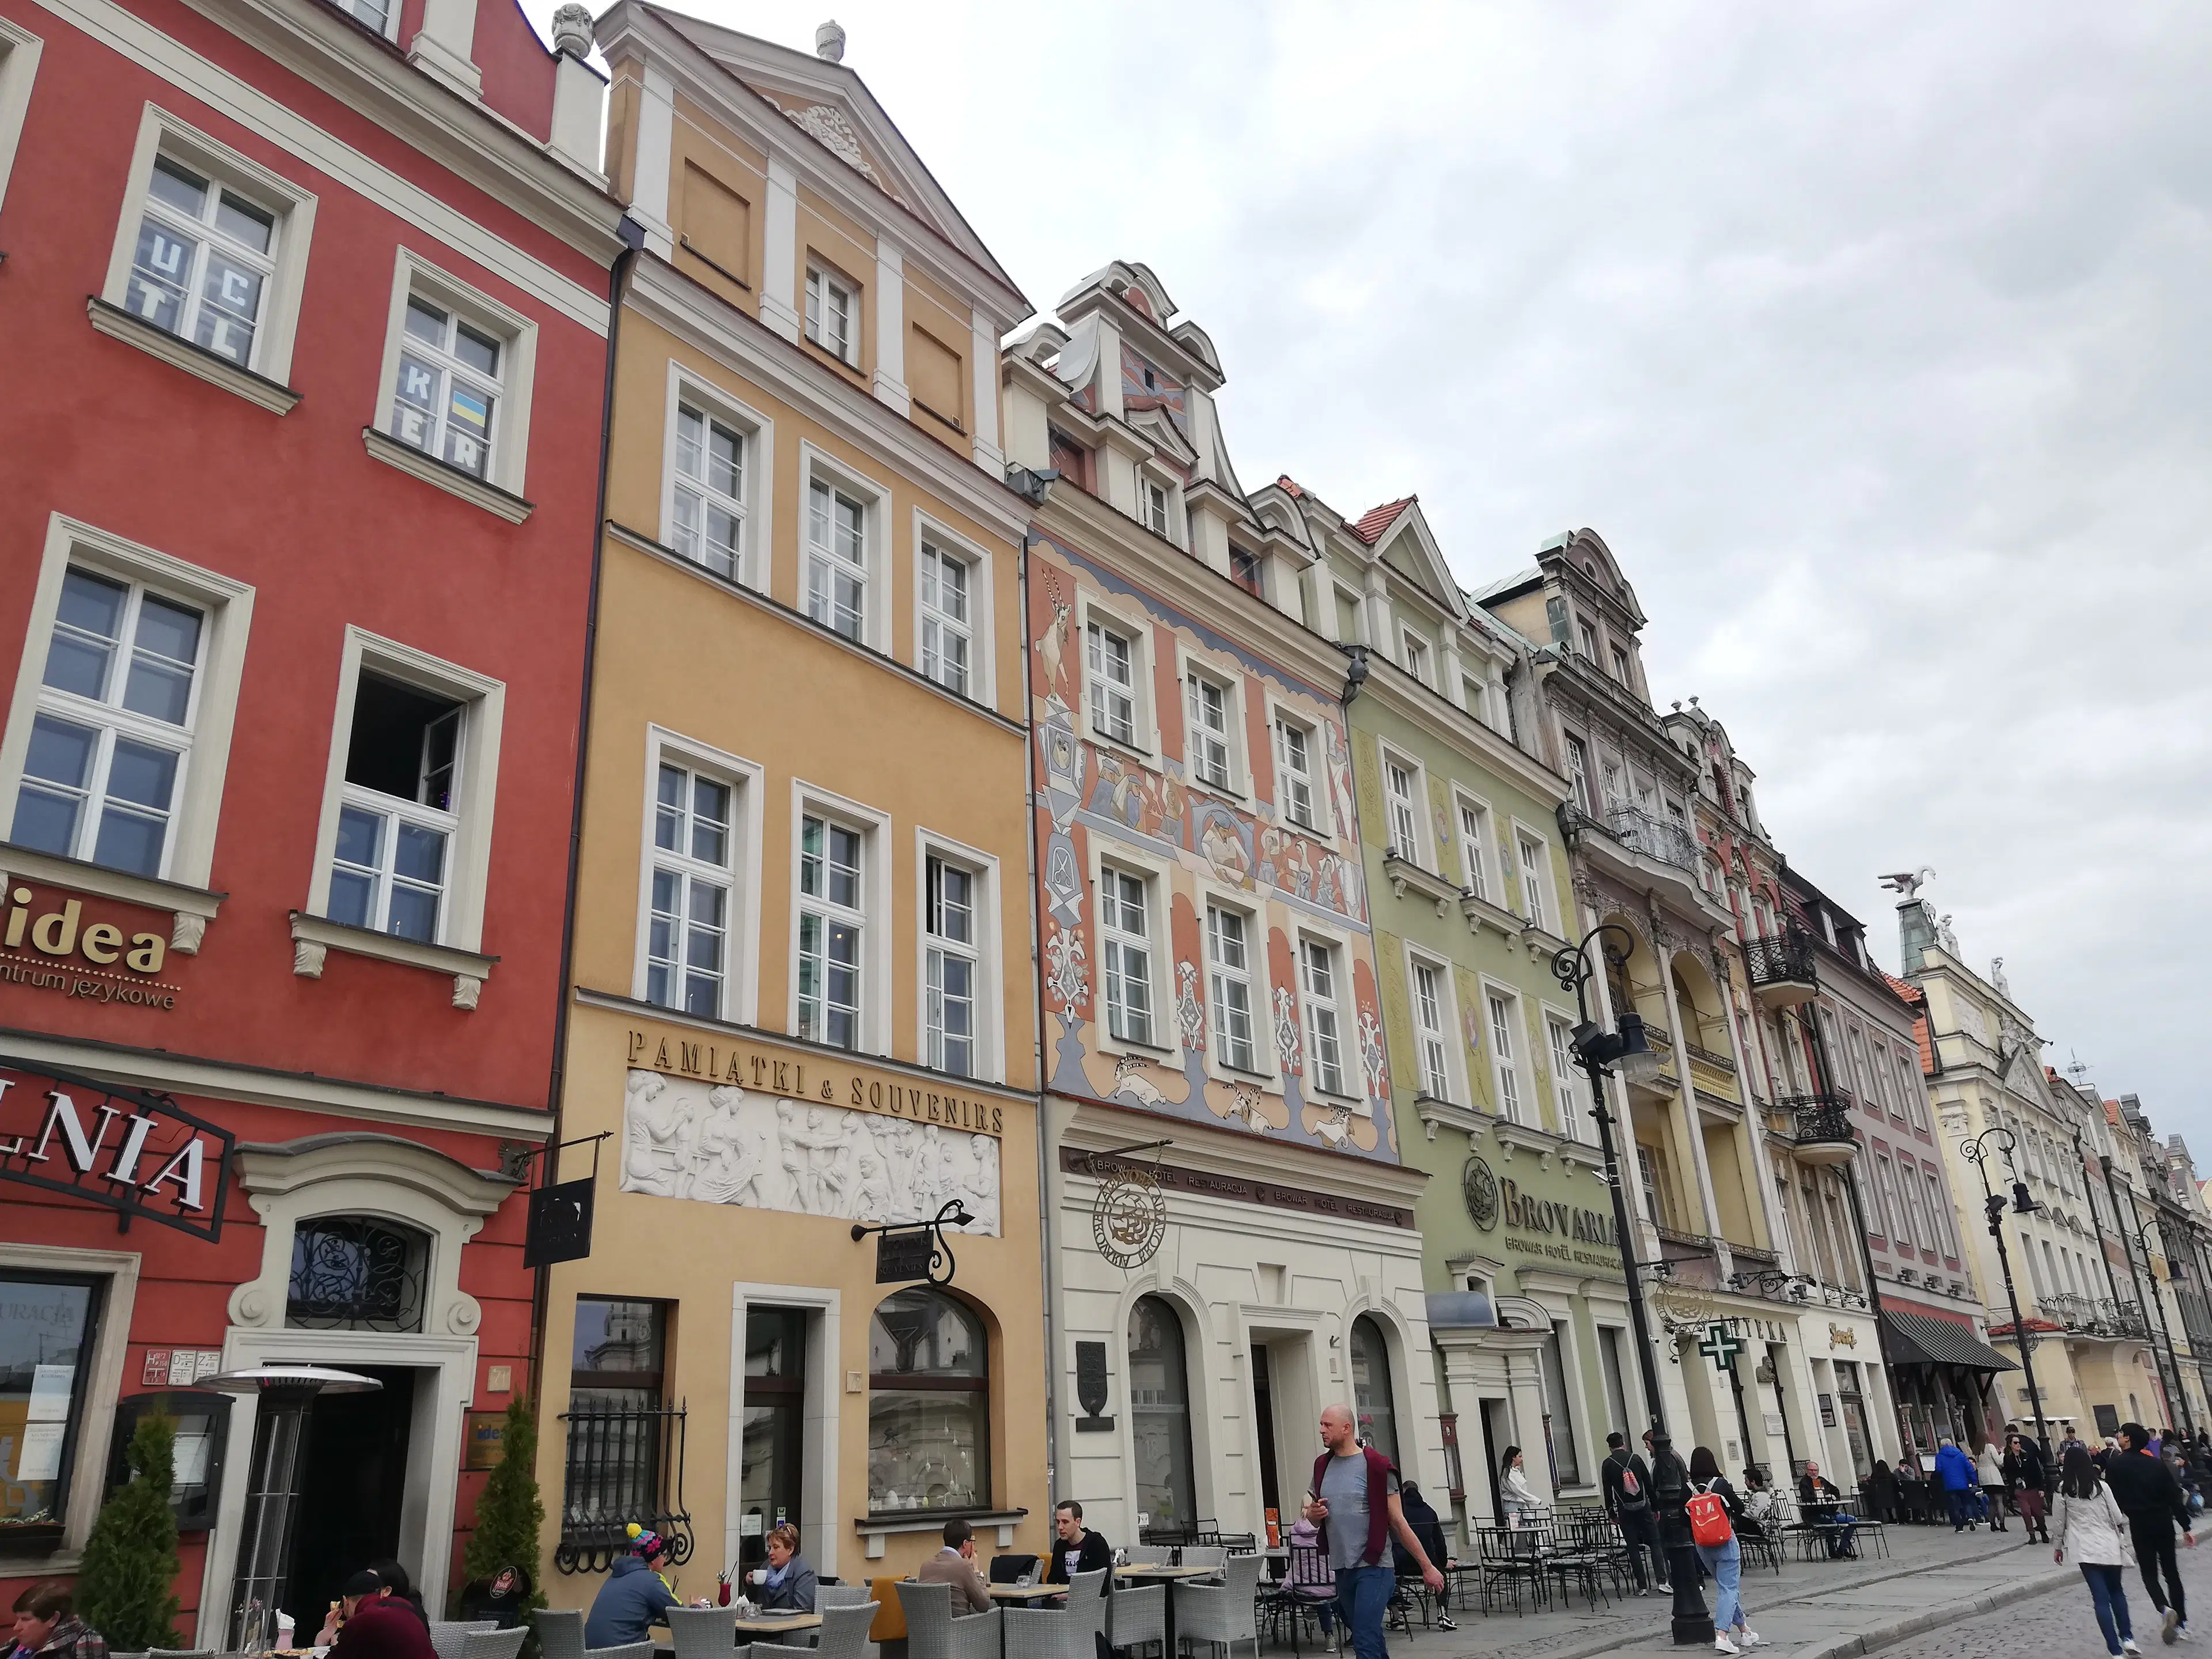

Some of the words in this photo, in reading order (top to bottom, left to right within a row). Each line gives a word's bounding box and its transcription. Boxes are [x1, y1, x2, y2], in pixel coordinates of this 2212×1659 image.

[5, 888, 166, 973] idea
[67, 975, 175, 1009] językowe
[627, 1030, 808, 1093] PAMIĄTKI
[821, 1080, 834, 1099] &
[851, 1077, 1005, 1133] SOUVENIRS
[1275, 1191, 1308, 1204] BROWAR
[1347, 1204, 1395, 1219] RESTAURACJA
[1500, 1176, 1621, 1248] BROVARIA
[1506, 1236, 1543, 1255] BROWAR
[1574, 1249, 1624, 1270] RESTAURACJ
[1720, 1314, 1787, 1342] APTEKA
